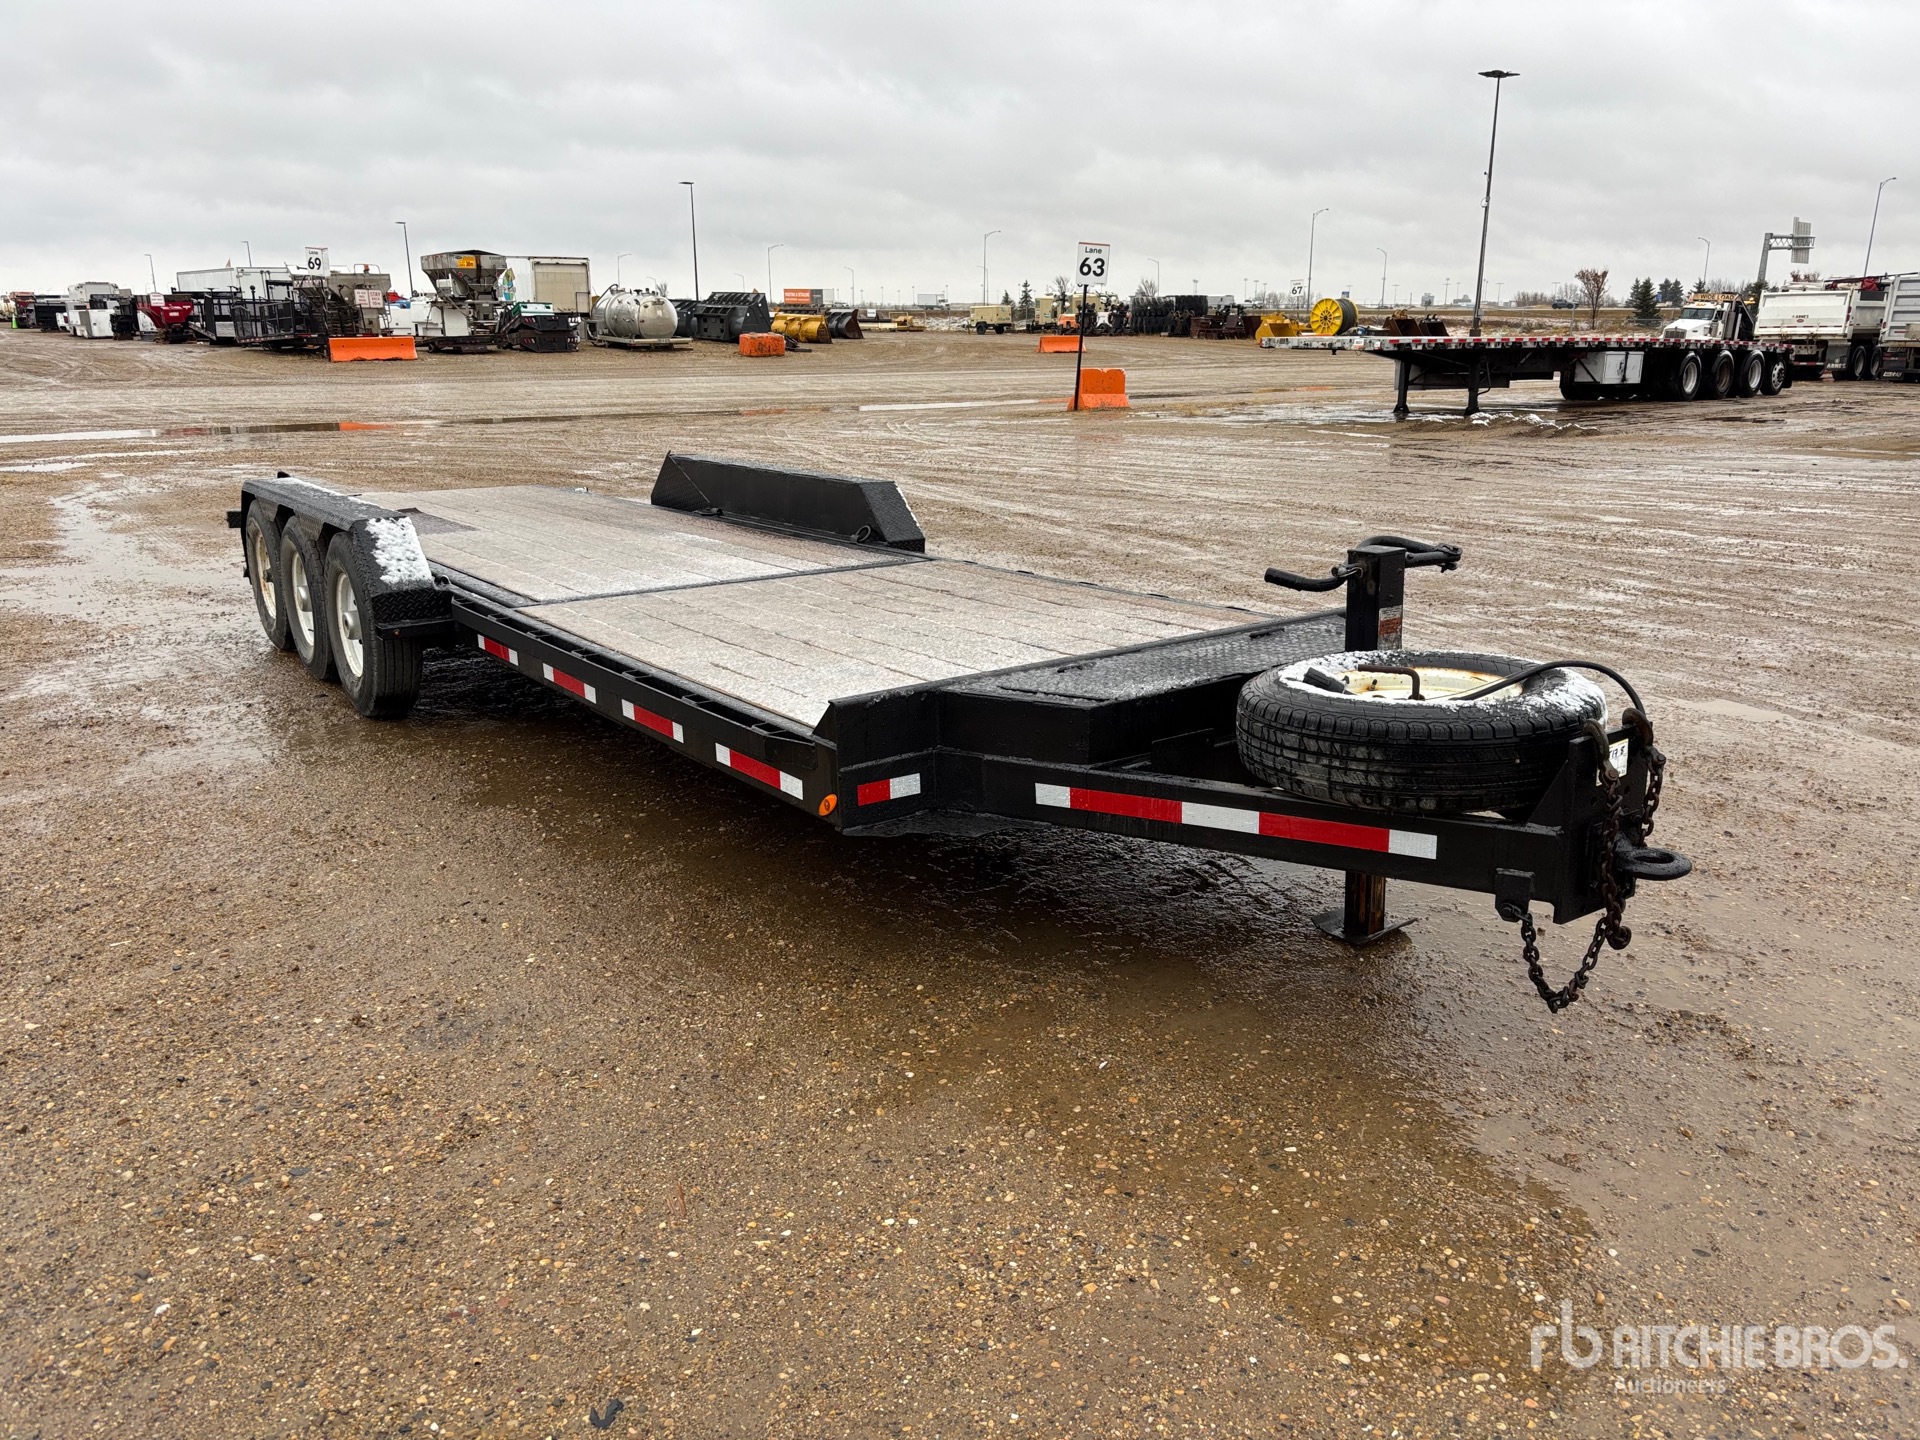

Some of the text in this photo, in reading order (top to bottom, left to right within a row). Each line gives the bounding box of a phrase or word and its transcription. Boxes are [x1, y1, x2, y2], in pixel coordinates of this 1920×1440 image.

[1085, 246, 1102, 254] Lane
[308, 257, 321, 270] 69
[1079, 257, 1105, 277] 63
[1292, 286, 1303, 295] 67
